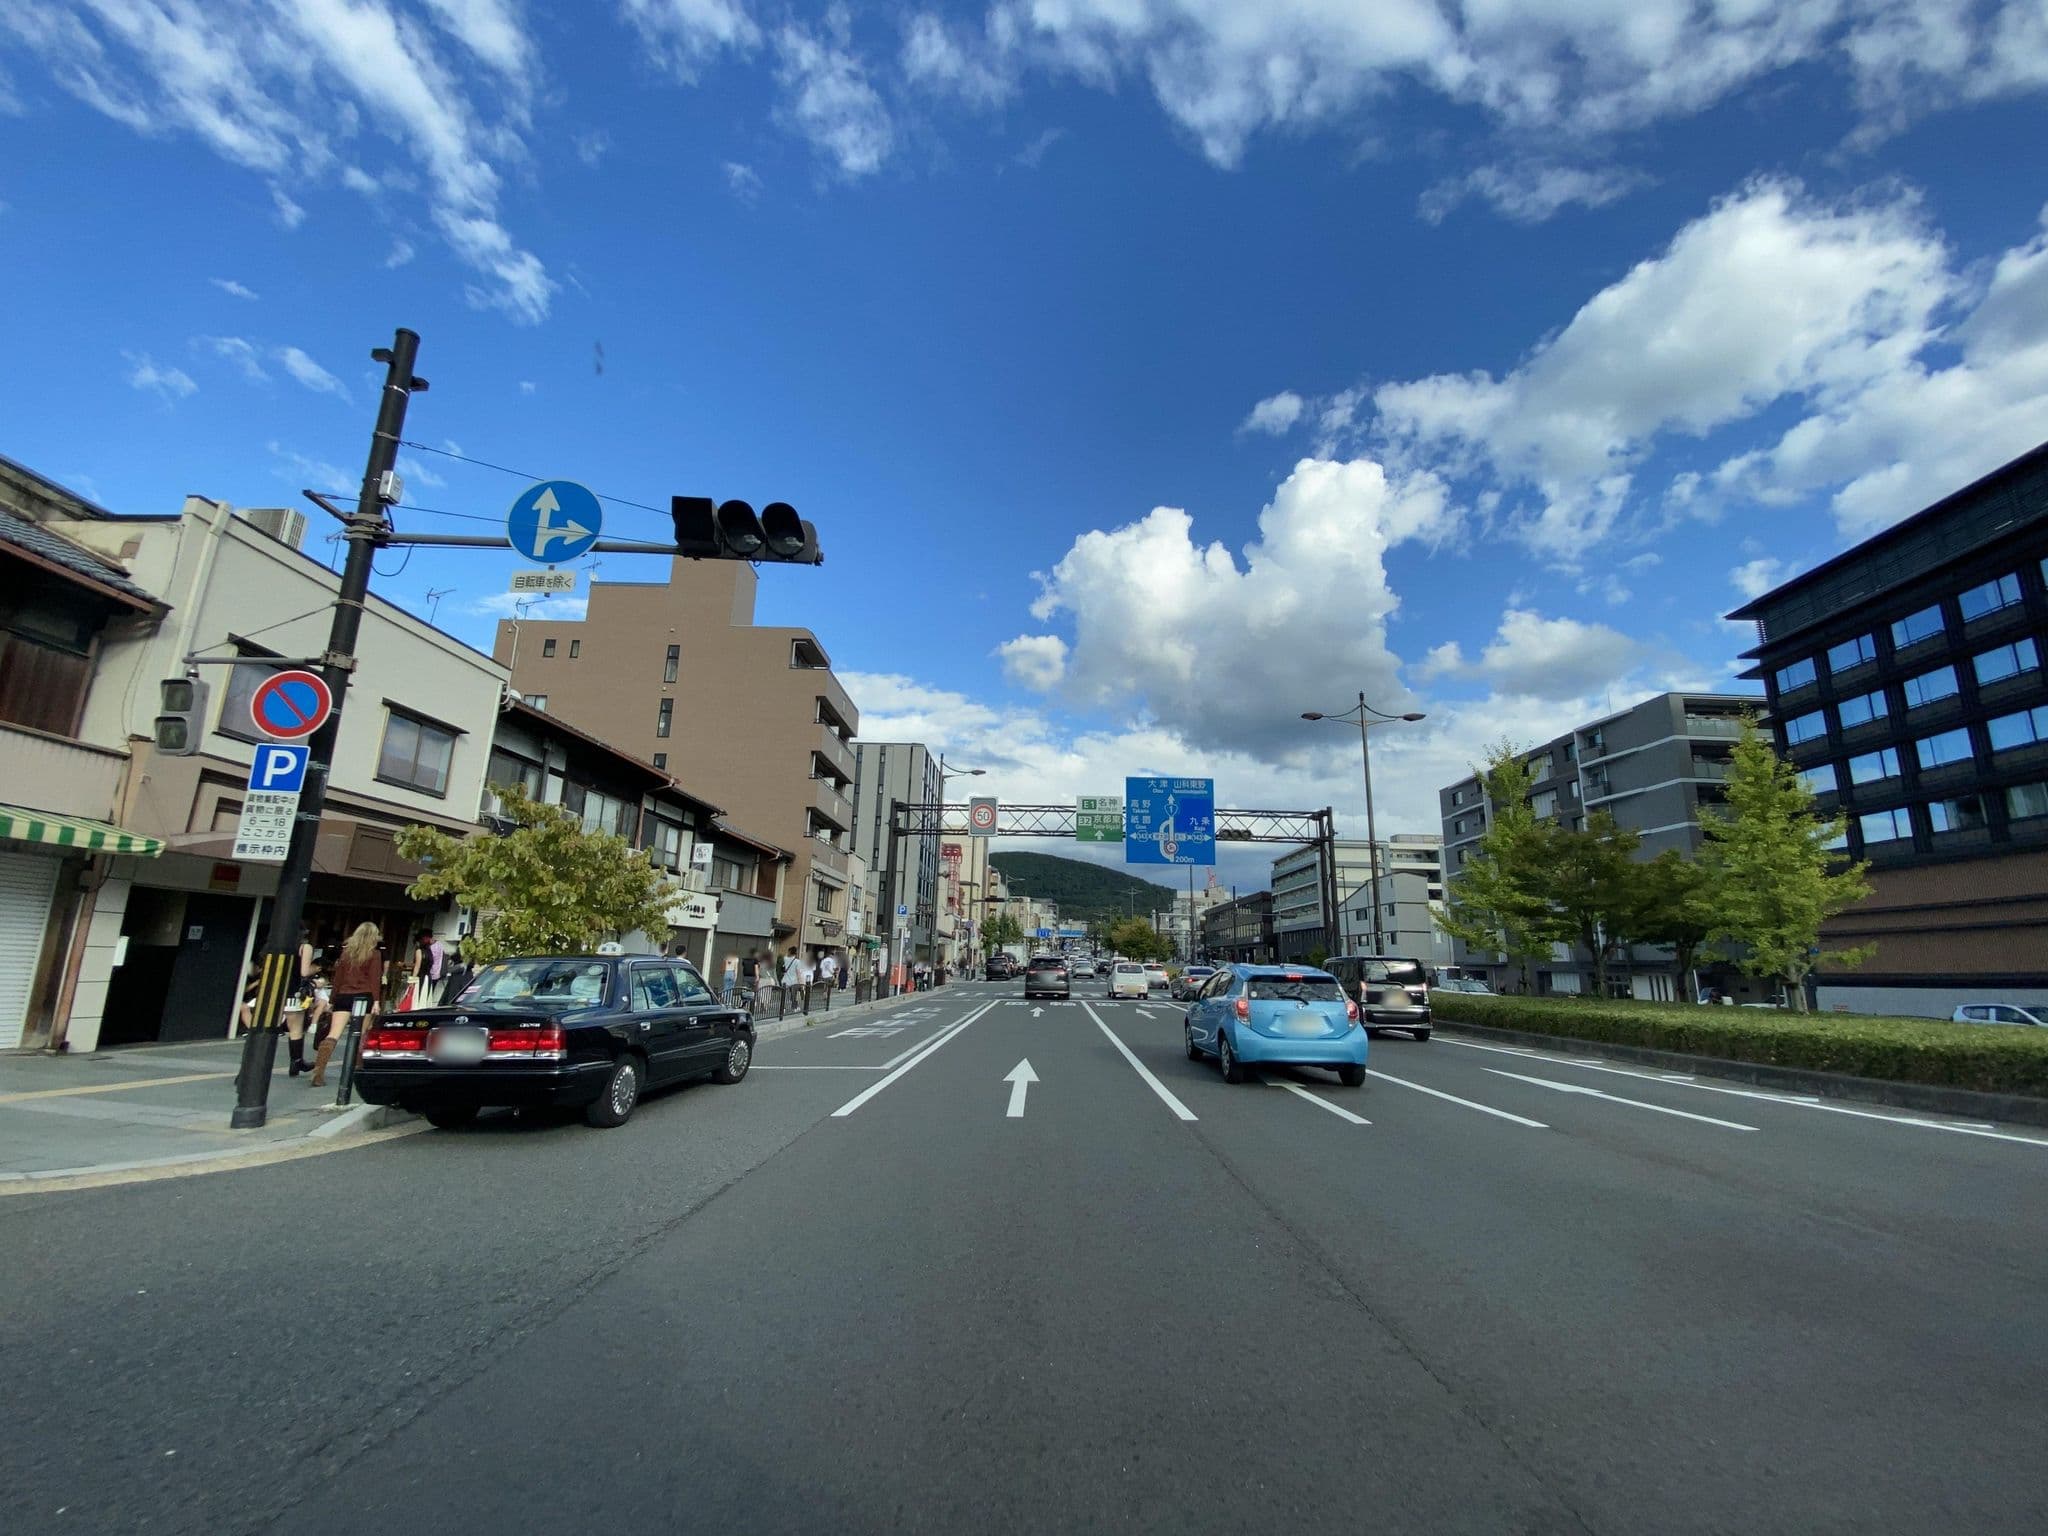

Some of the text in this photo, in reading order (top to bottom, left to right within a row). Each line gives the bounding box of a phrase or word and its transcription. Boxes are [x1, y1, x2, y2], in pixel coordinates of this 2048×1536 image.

[514, 575, 572, 588] 自転車を除く
[262, 749, 298, 787] P
[1083, 800, 1095, 809] E1
[977, 811, 990, 821] 50
[242, 827, 287, 839] ここから
